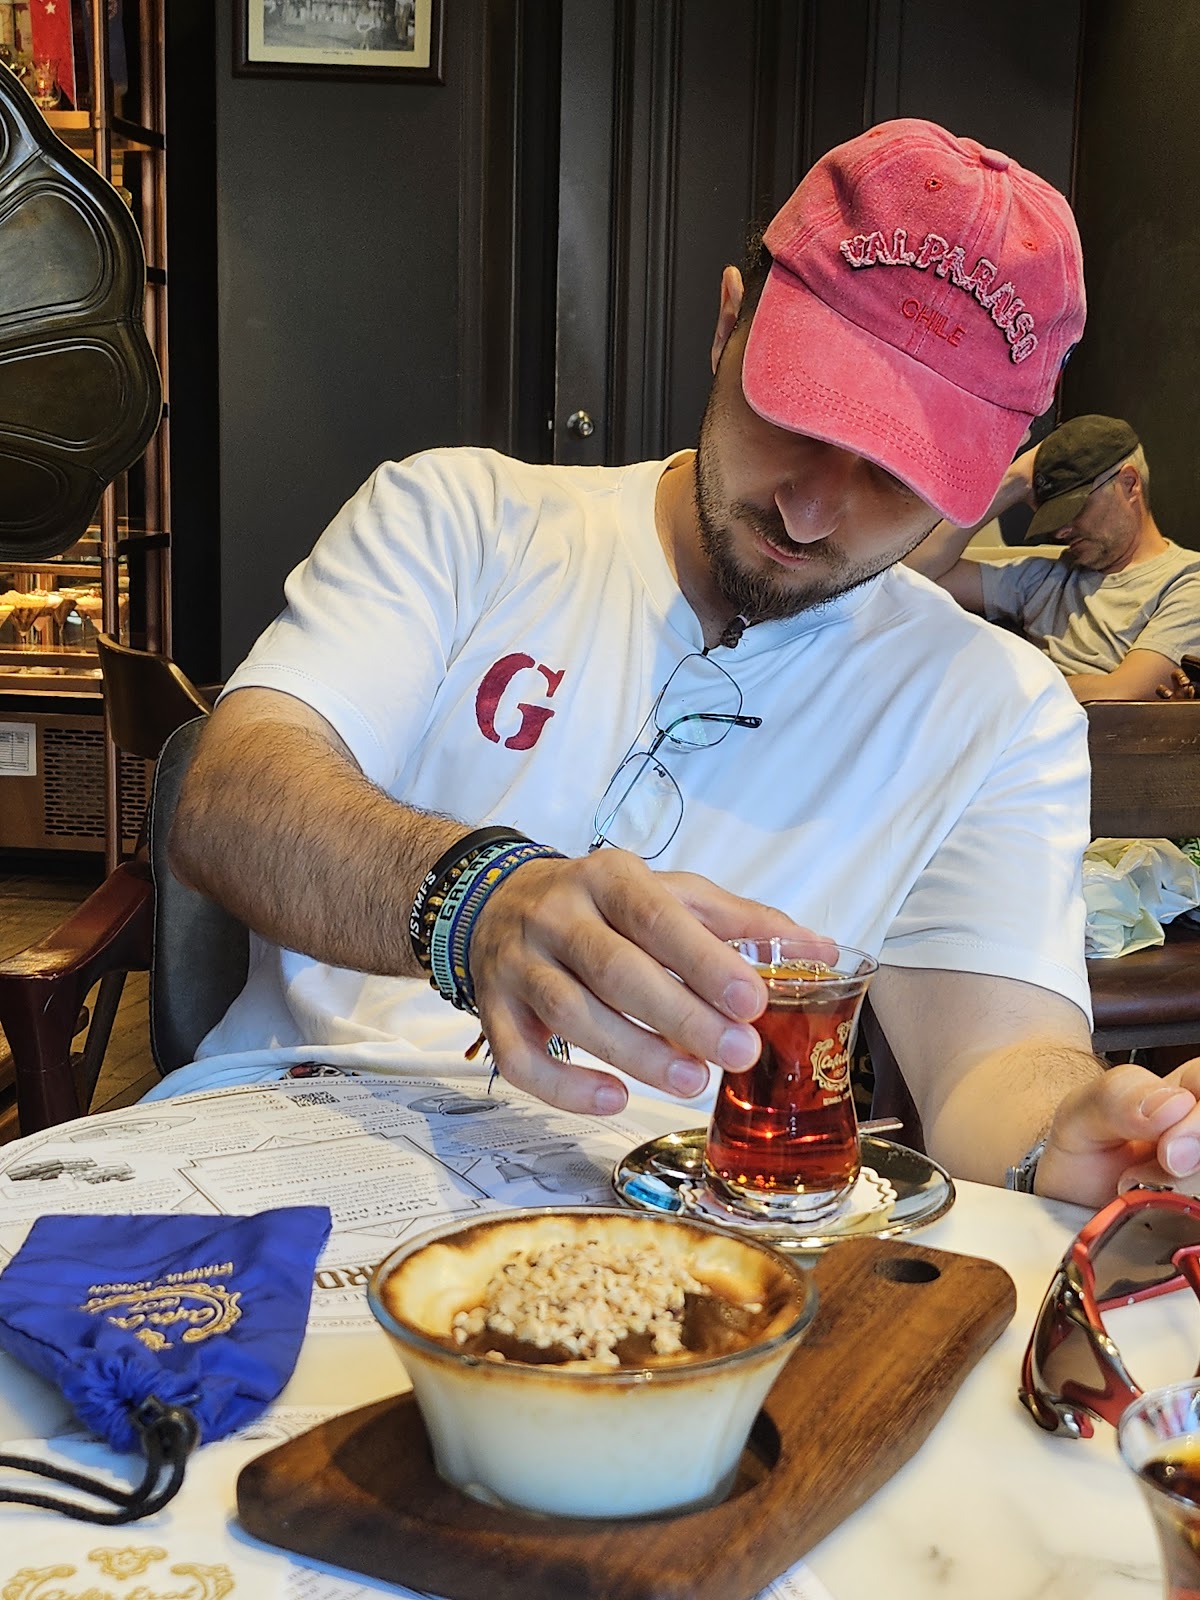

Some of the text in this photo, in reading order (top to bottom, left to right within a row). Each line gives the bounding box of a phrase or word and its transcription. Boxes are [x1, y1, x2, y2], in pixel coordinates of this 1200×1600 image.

[838, 227, 1039, 365] VALPARAISO
[901, 297, 967, 348] CHILE
[474, 651, 566, 752] G
